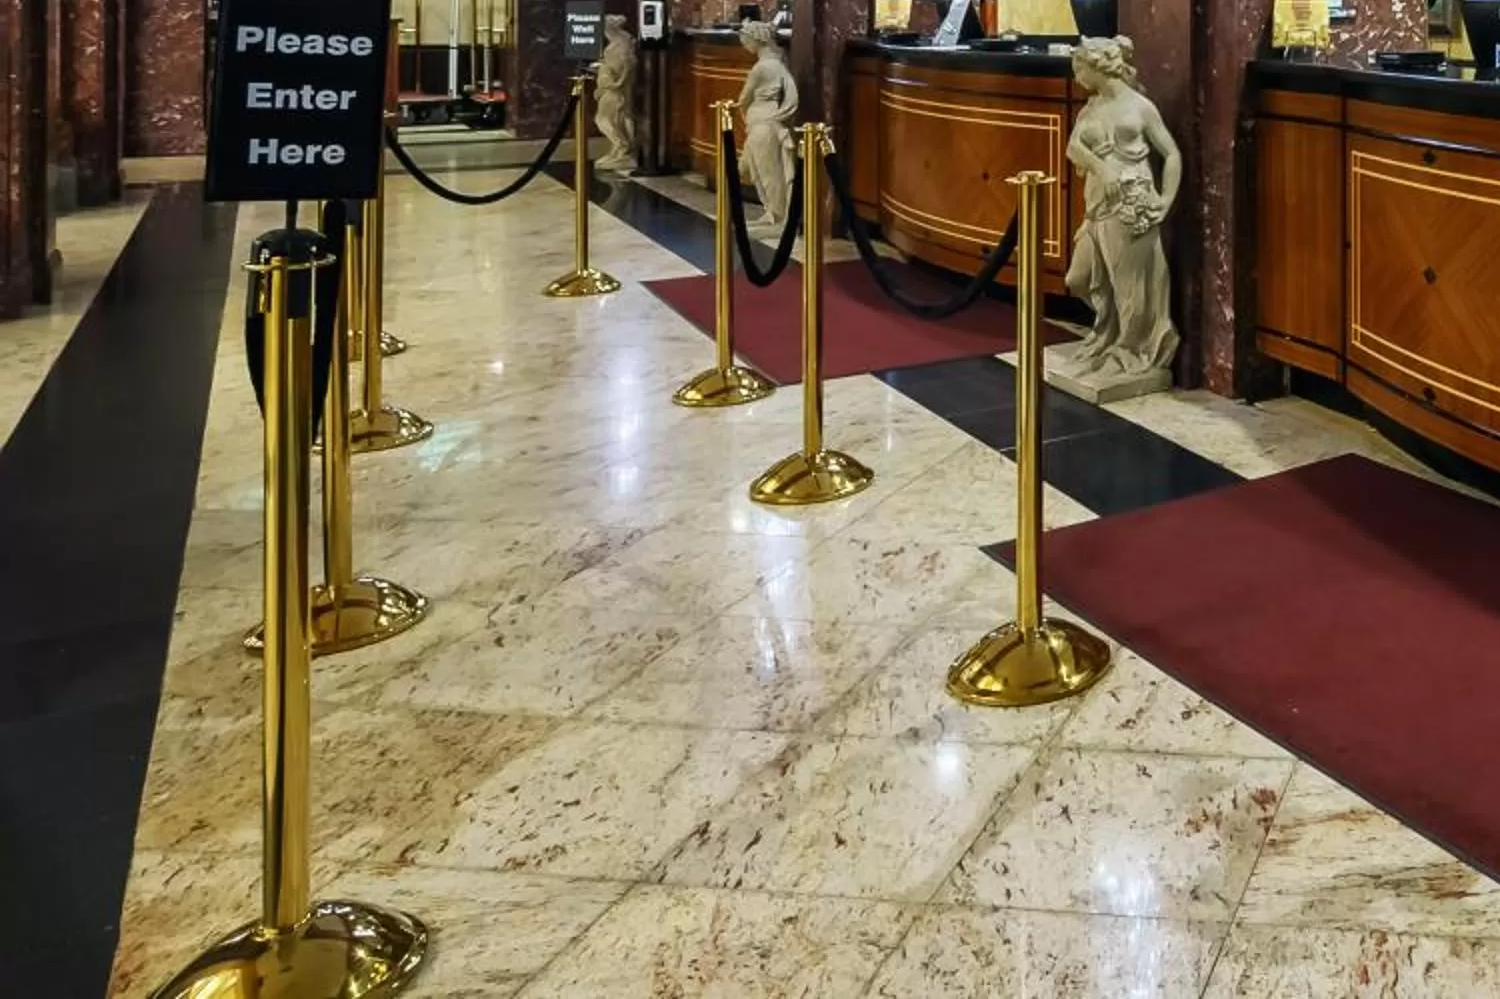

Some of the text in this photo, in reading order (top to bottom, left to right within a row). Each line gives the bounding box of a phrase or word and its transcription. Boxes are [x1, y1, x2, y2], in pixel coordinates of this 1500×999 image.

[236, 24, 373, 56] Please
[246, 82, 357, 110] Enter
[248, 138, 345, 164] Here
